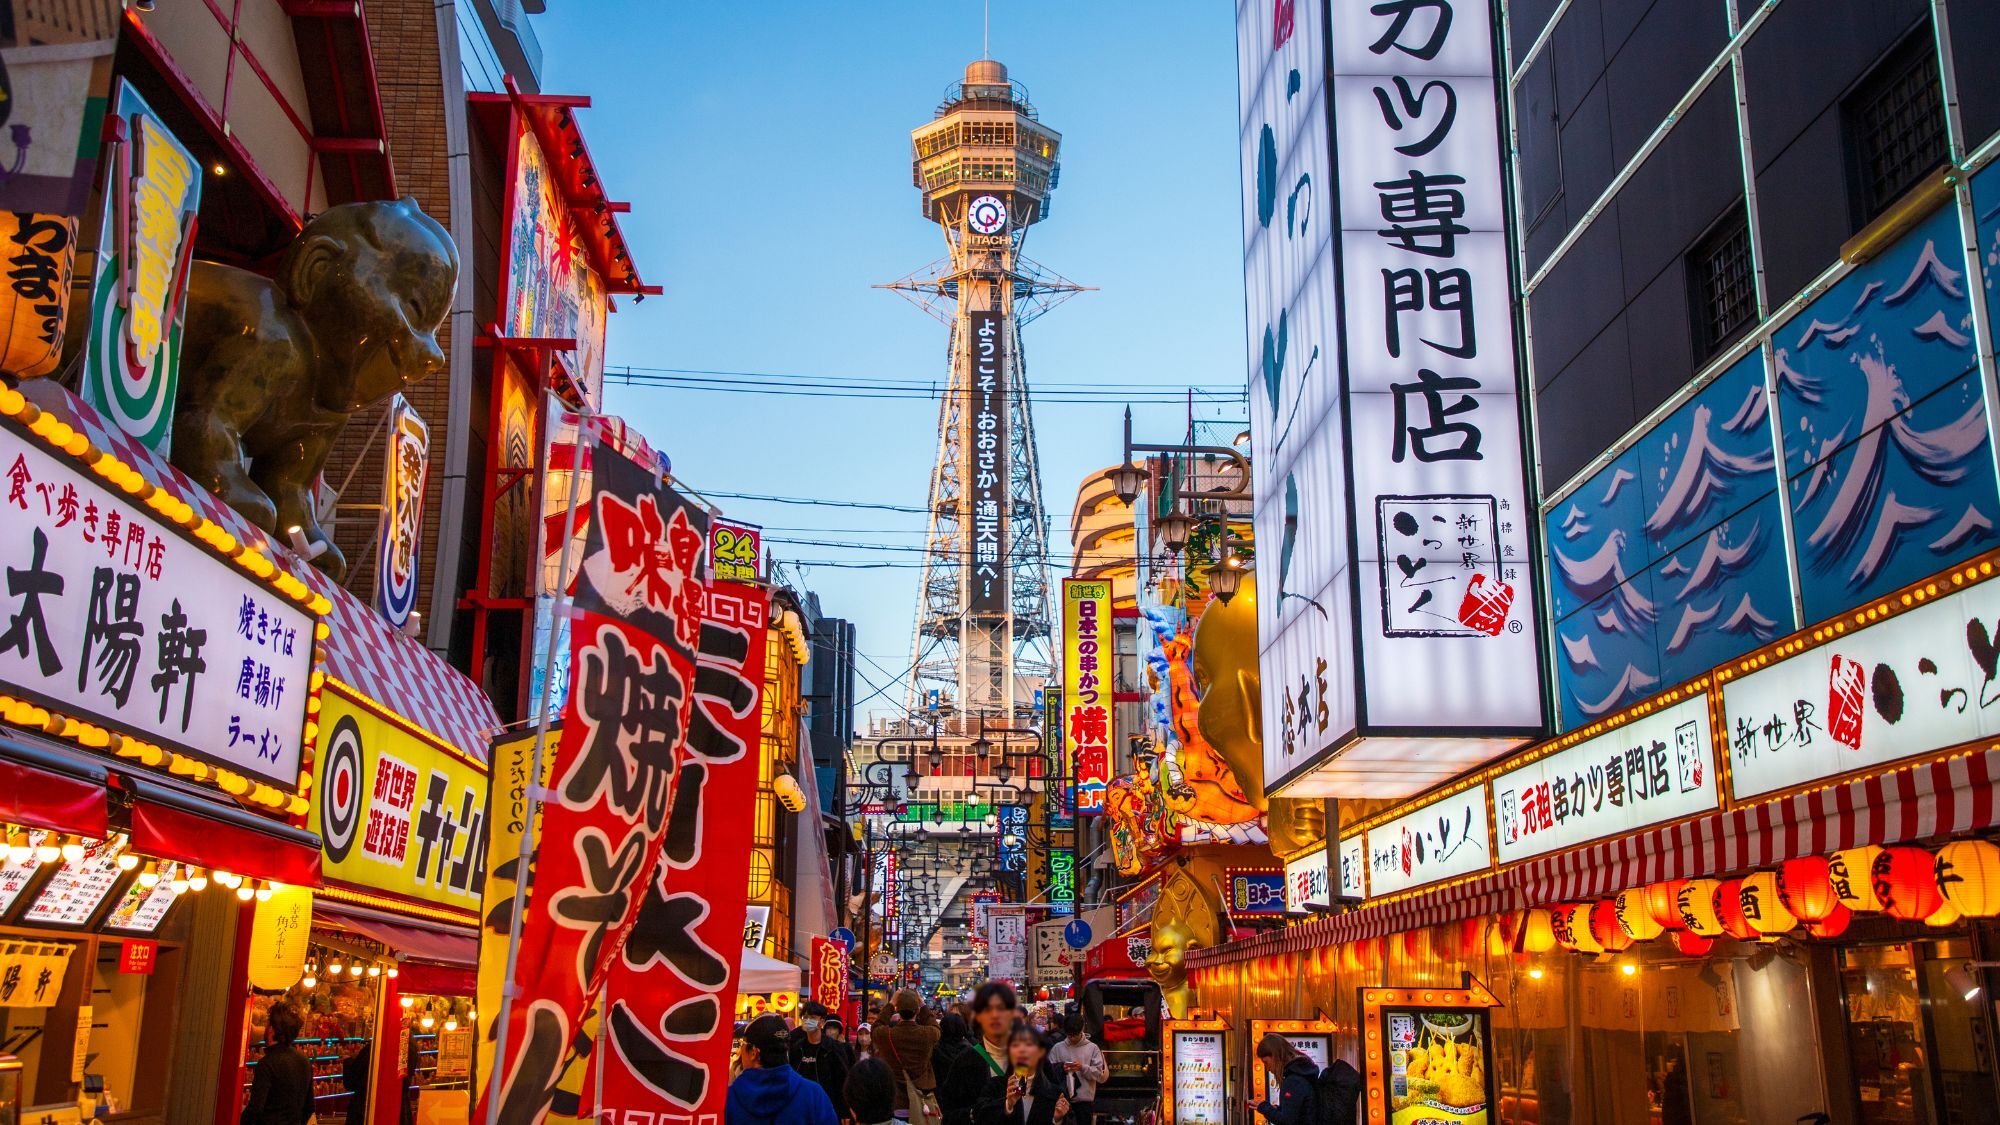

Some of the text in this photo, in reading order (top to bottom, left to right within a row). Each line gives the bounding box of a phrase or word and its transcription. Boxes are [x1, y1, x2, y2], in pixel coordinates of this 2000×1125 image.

[963, 234, 1012, 245] HITACHI
[6, 453, 166, 582] 食べ歩き専門店
[1455, 512, 1486, 571] 新世界
[714, 529, 756, 565] 24
[0, 526, 207, 735] 太陽軒
[237, 593, 297, 661] 焼きそば
[1077, 601, 1100, 705] 日本一の串かつ
[236, 655, 286, 713] 唐揚げ
[228, 715, 283, 765] ラーメン
[373, 758, 418, 802] 新世界
[1521, 740, 1671, 836] 元祖串カツ専門店
[362, 808, 408, 865] 遊技場
